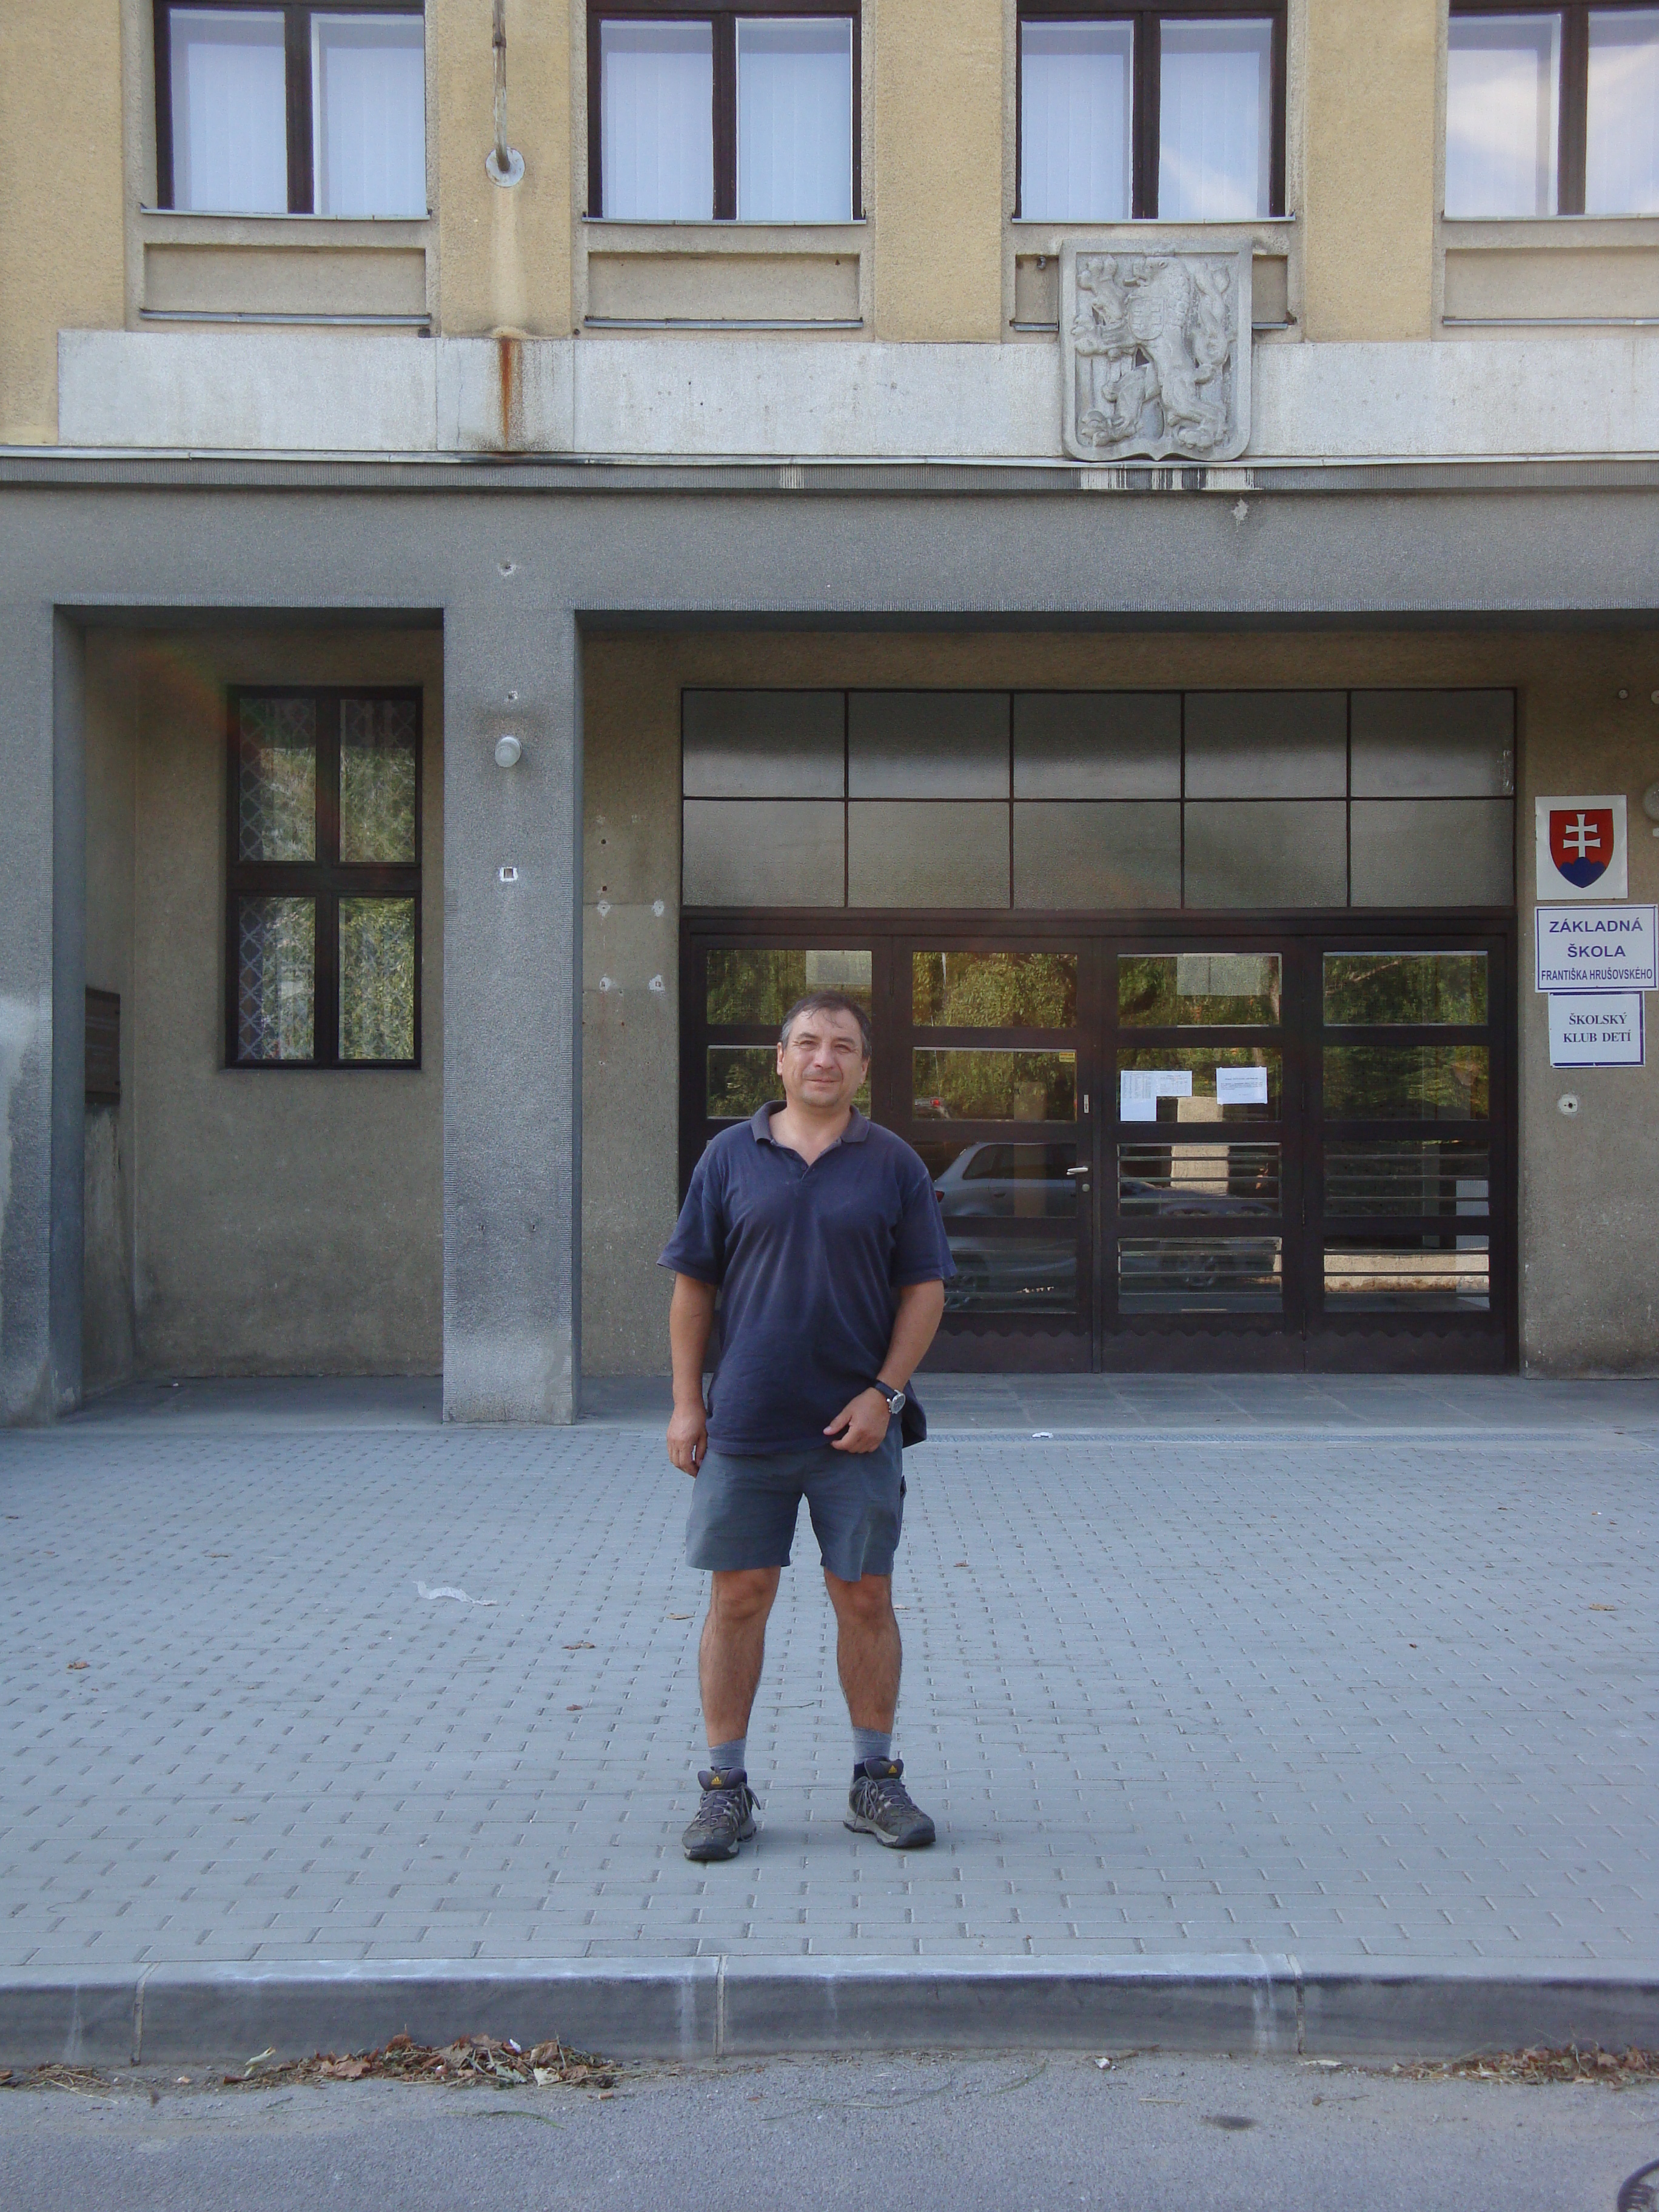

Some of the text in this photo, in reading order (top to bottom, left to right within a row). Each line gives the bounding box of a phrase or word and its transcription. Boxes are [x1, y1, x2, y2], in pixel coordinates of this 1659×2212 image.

[1549, 917, 1643, 933] ZÁKLADNÁ
[1567, 943, 1626, 957] ŠKOLA
[1541, 967, 1652, 980] FRANTIŠKA HRUŠOVSKÉHO
[1569, 1012, 1627, 1025] ŠKOLSKÝ
[1563, 1030, 1632, 1042] KLUB DETÍ
